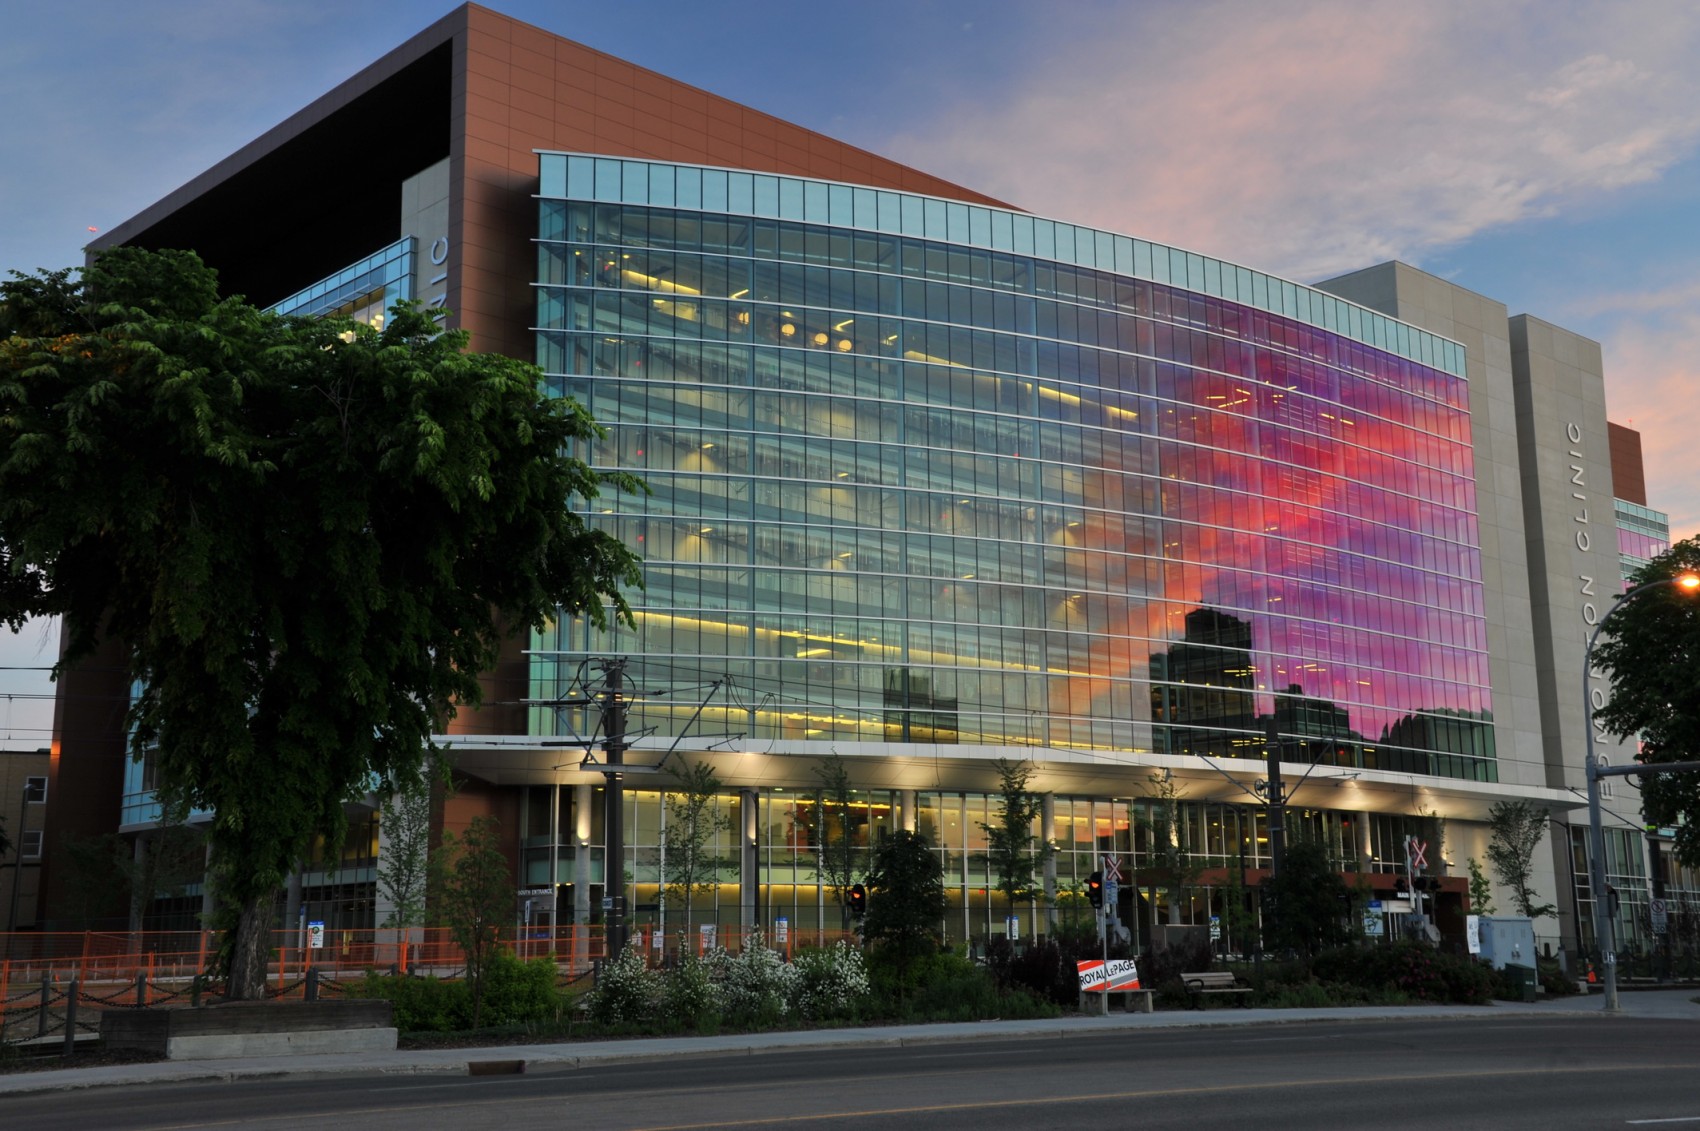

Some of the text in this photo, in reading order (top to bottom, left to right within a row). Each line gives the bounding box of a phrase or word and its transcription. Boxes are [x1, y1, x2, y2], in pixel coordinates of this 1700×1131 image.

[1566, 421, 1591, 552] CLINIC
[531, 888, 553, 896] ENTRANCE
[1079, 969, 1105, 986] ROYAL
